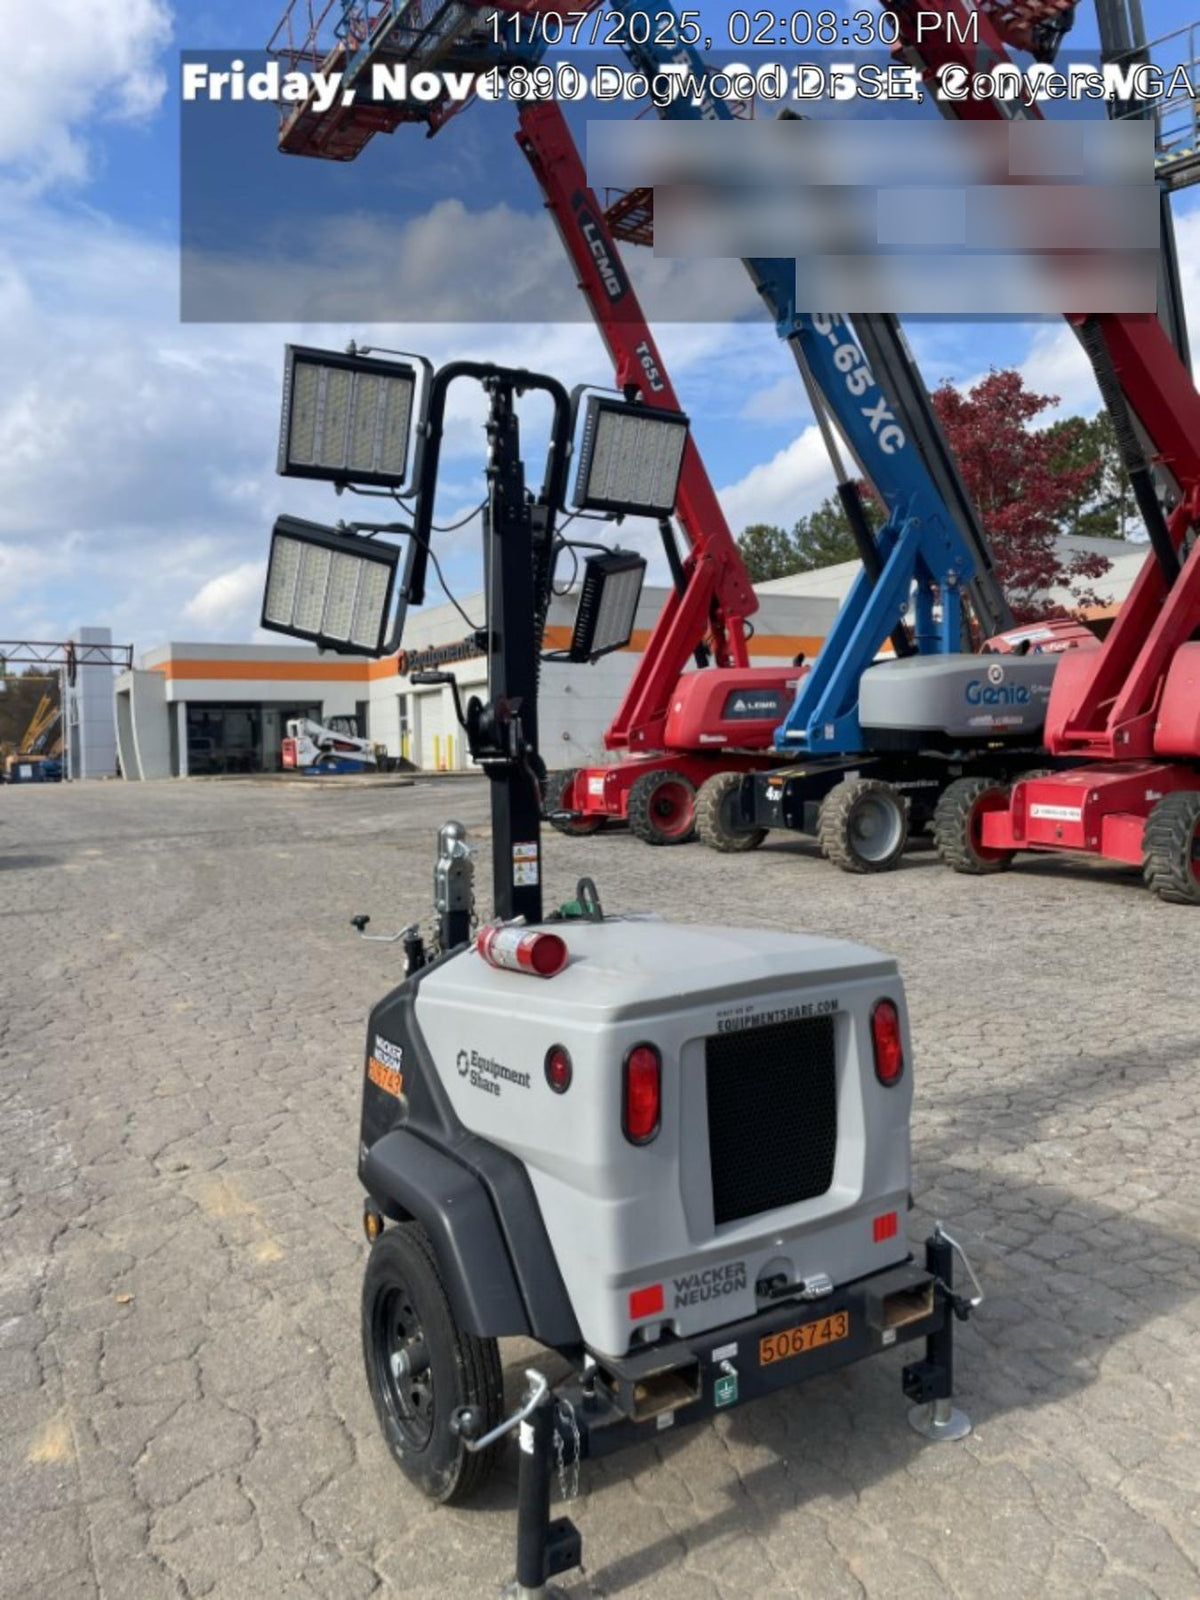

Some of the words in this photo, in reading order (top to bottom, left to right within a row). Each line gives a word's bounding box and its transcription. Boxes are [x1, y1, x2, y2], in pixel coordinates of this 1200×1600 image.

[635, 341, 665, 392] T65J
[860, 397, 906, 455] XC
[966, 680, 1031, 706] Genie
[717, 998, 839, 1033] EQUIPMENTSHARE.COM
[469, 1069, 501, 1096] Share
[470, 1050, 531, 1089] Equipment
[672, 1261, 747, 1293] WACKER
[674, 1275, 747, 1310] NEUSON
[761, 1313, 848, 1363] 506743
